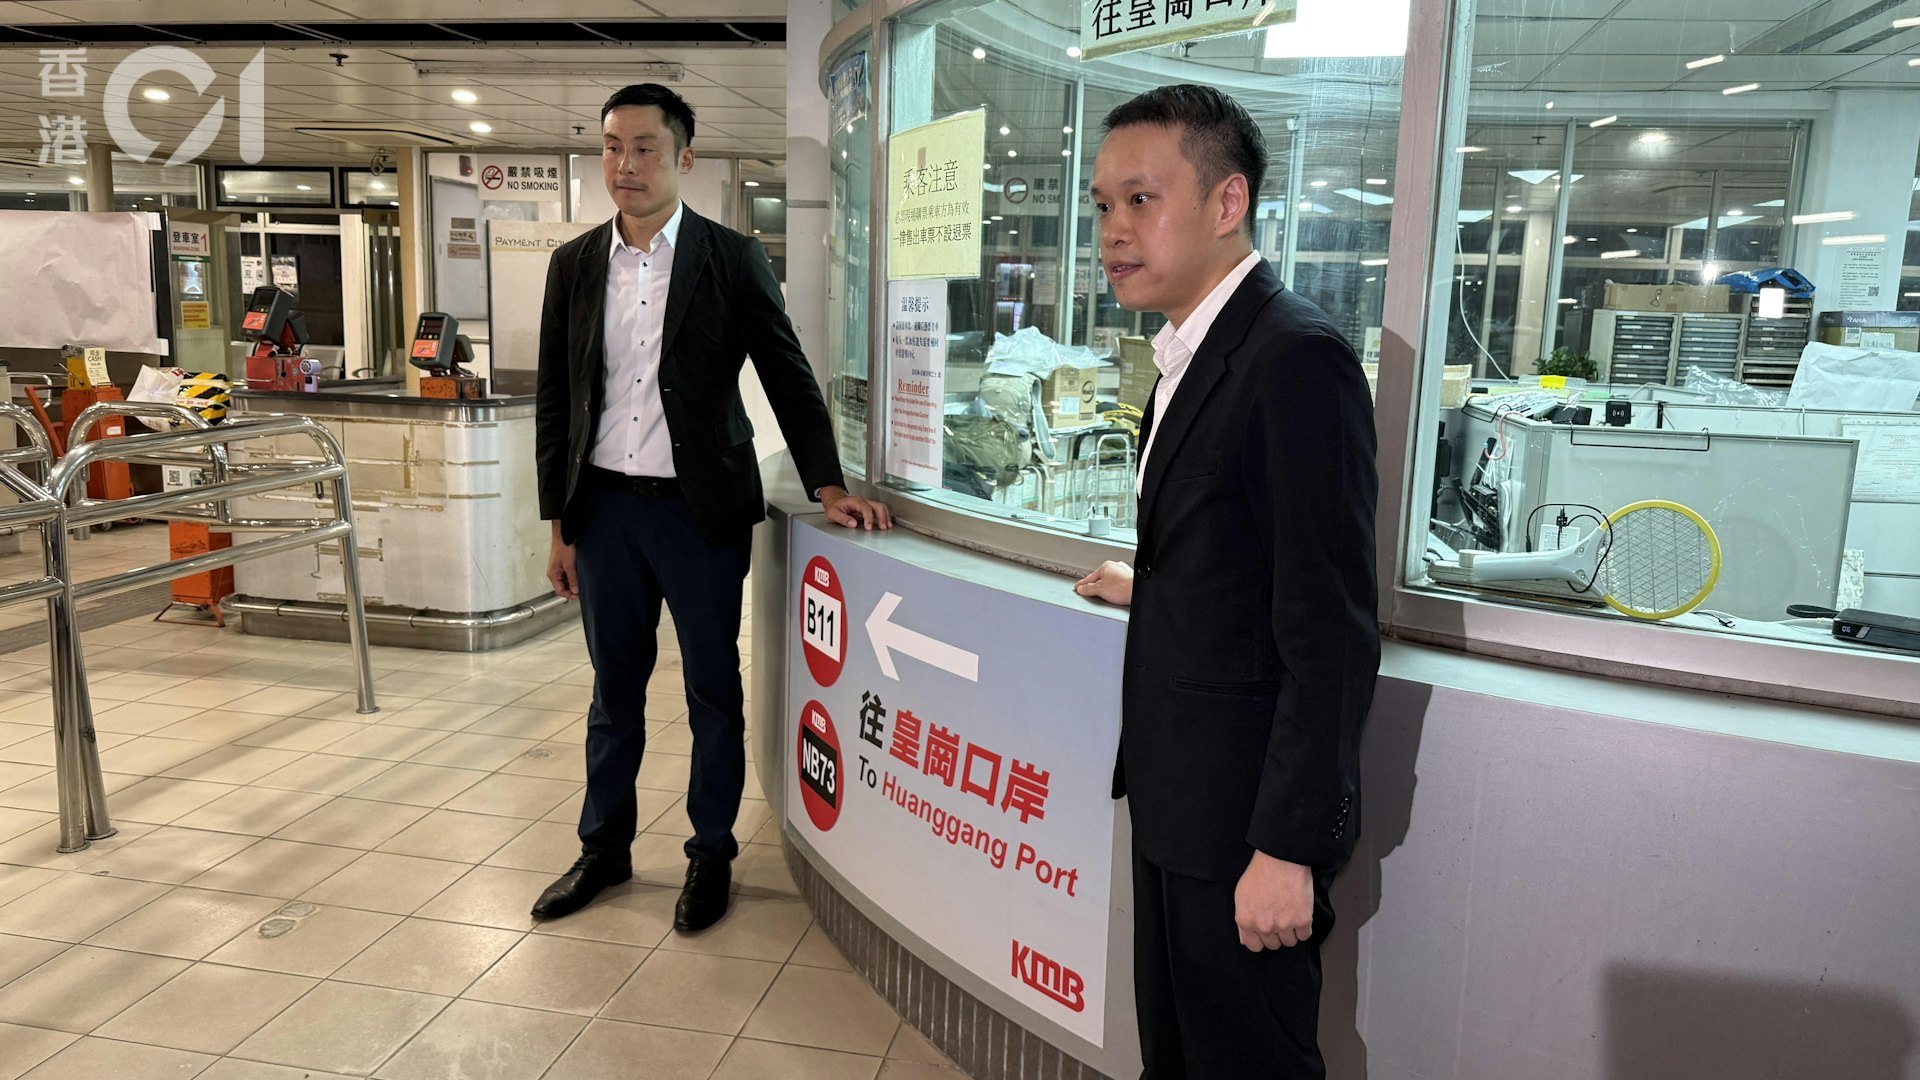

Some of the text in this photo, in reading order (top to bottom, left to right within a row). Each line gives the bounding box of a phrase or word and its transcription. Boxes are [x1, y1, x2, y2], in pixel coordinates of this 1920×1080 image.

[507, 166, 558, 179] 嚴禁吸煙
[507, 181, 559, 191] NO SMOKING
[903, 159, 958, 198] 乘客注意
[172, 231, 200, 244] 登車室
[893, 223, 972, 247] 一律售出車票不設退票
[898, 378, 930, 395] Reminder
[807, 597, 834, 647] B11
[802, 737, 836, 794] NB73
[859, 690, 1050, 824] 往皇崗口岸
[858, 754, 1079, 898] To Huanggang Port
